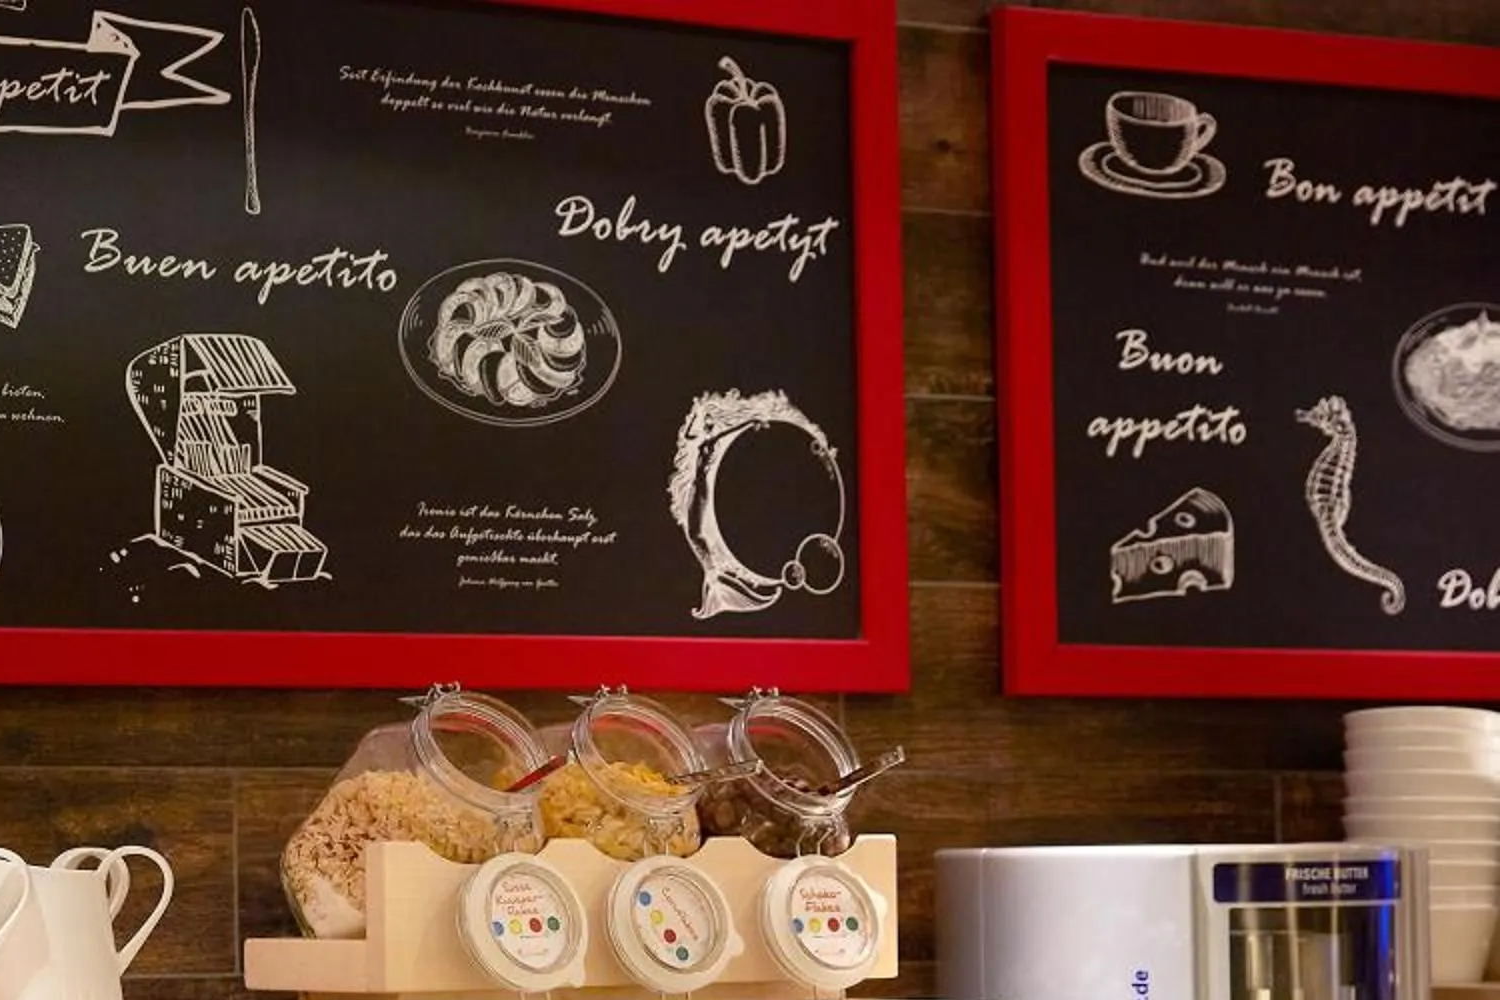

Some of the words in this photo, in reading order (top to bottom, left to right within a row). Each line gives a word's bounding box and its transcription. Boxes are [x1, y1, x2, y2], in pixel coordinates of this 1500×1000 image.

[1263, 157, 1342, 204] Bon
[555, 195, 686, 273] Dobry
[700, 212, 840, 282] apetyt
[81, 228, 217, 281] Buen
[234, 245, 398, 304] apetito
[1115, 328, 1223, 376] Buon
[1087, 404, 1248, 458] appetito
[1285, 867, 1331, 881] FRISCHE
